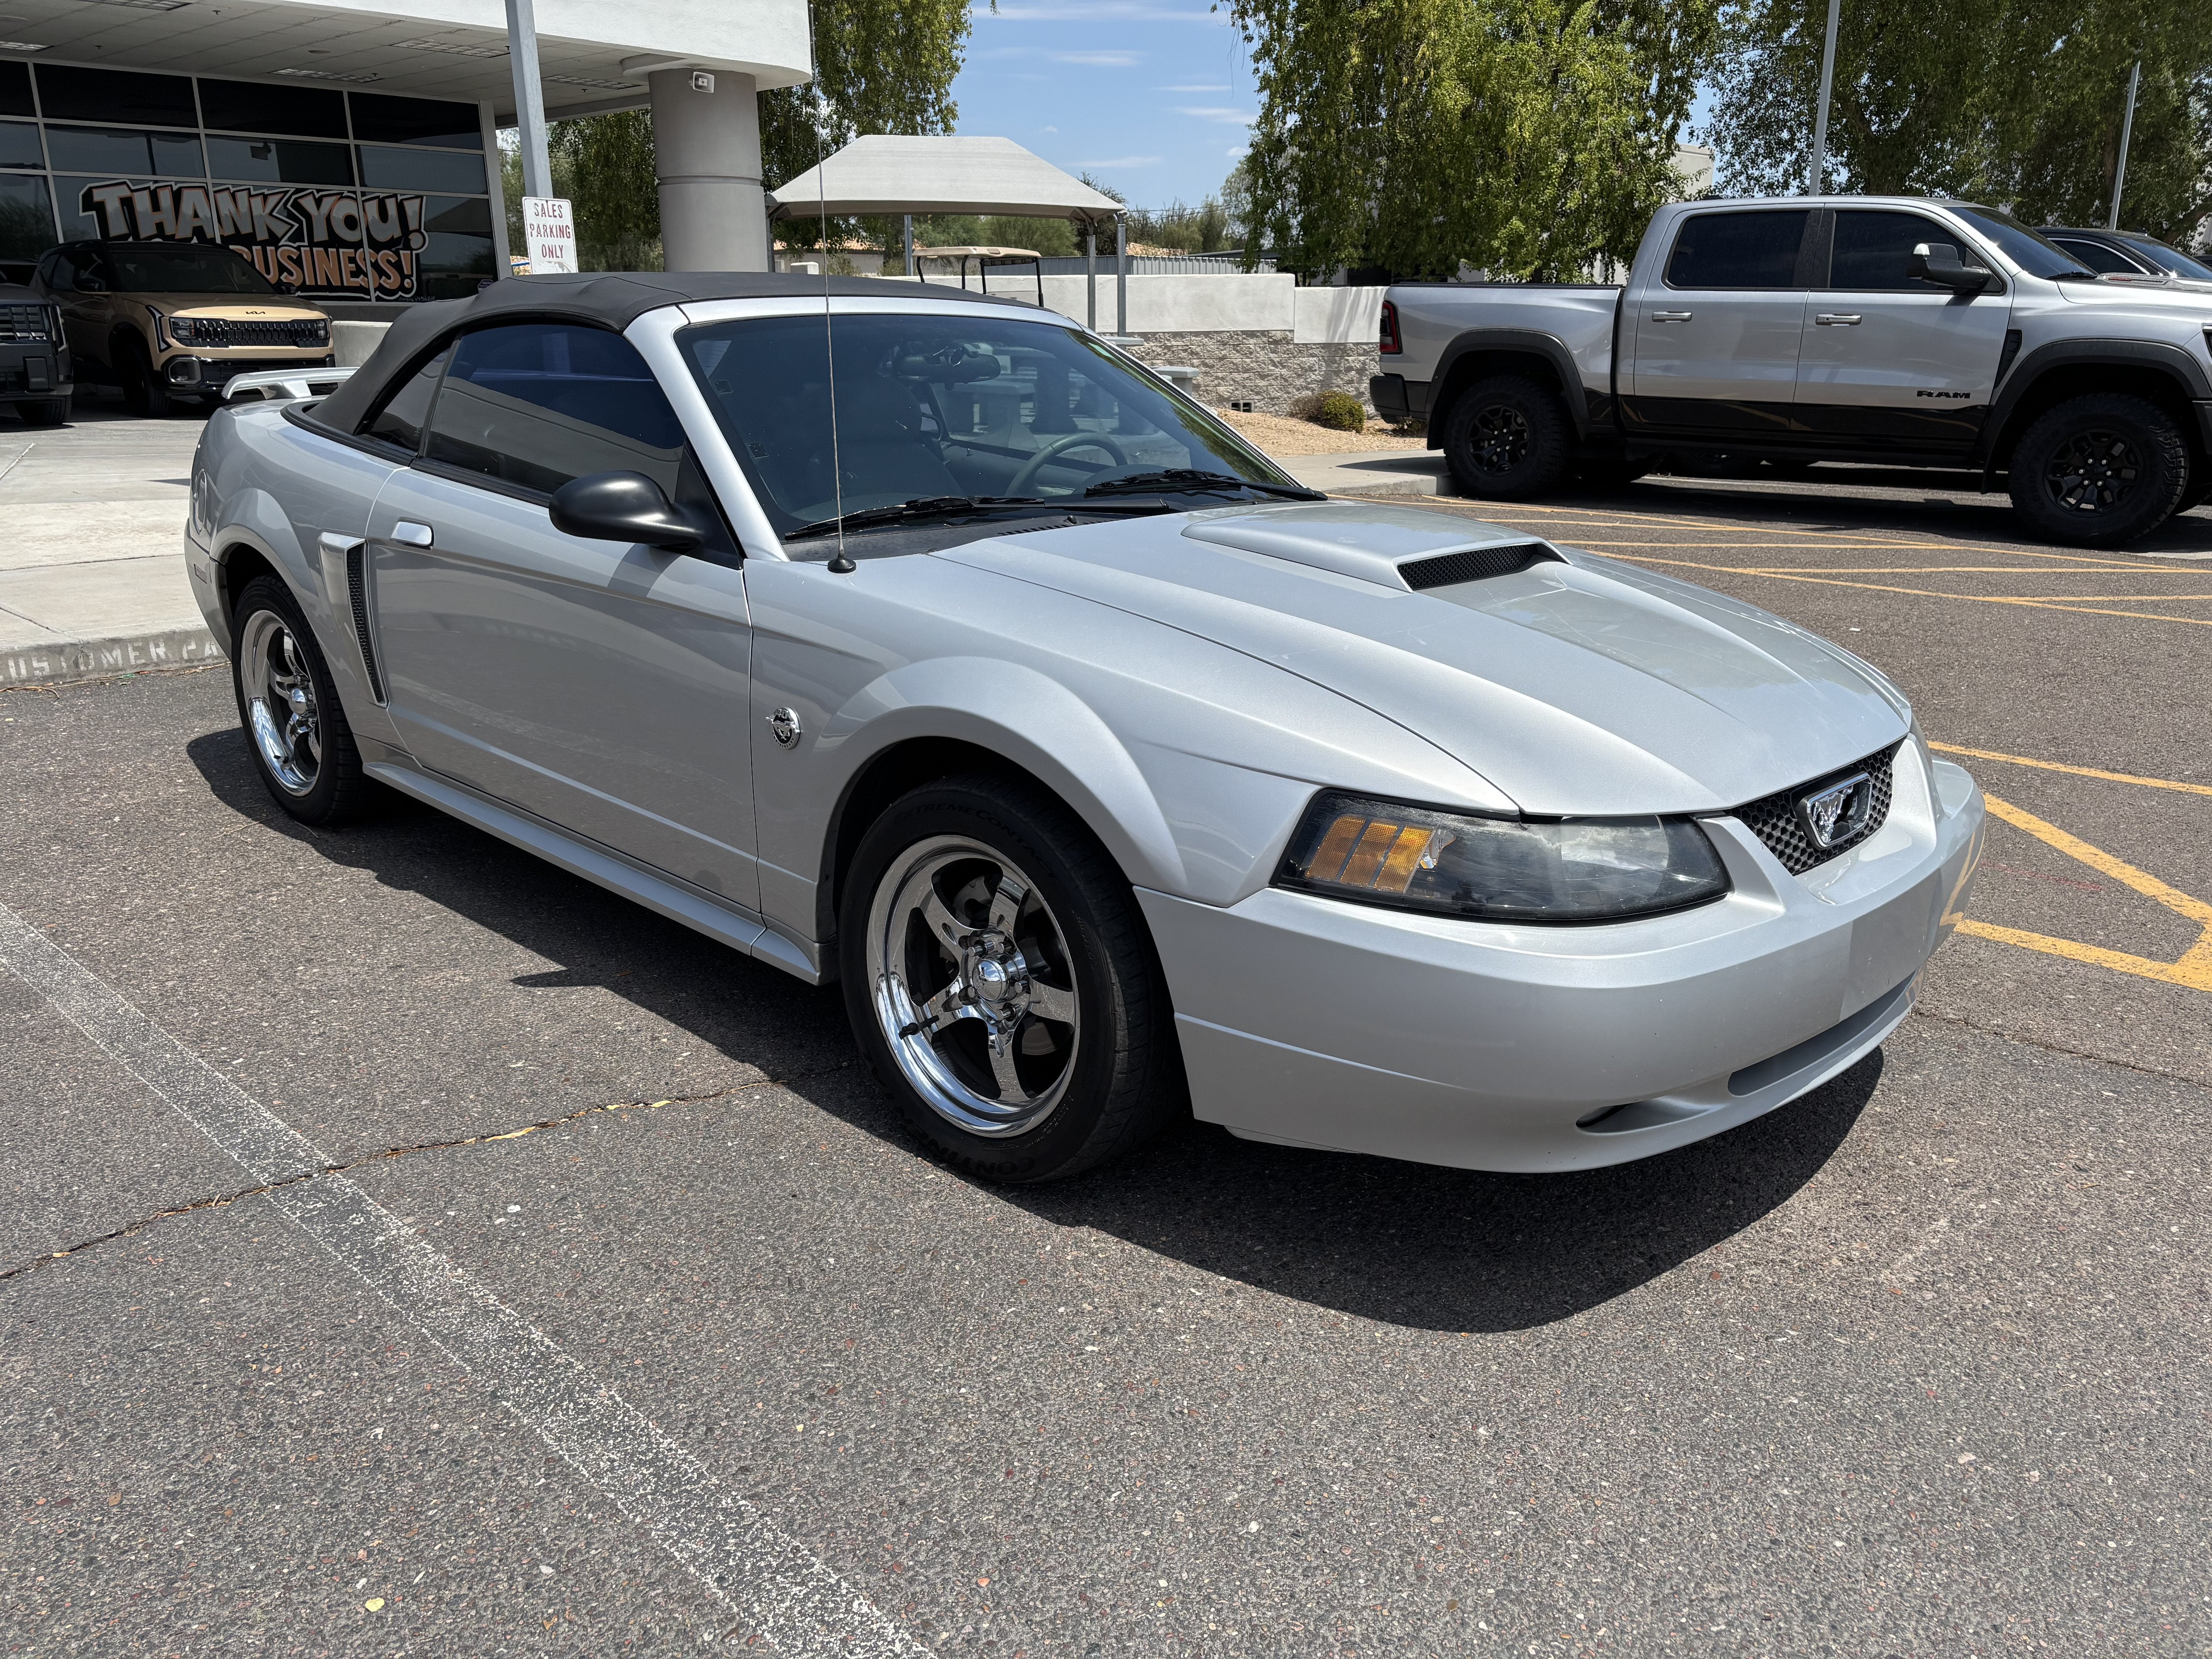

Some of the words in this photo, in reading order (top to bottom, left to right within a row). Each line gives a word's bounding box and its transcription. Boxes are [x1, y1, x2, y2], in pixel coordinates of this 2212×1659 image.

[92, 184, 291, 241] THANK
[298, 194, 424, 249] YOU!
[534, 203, 563, 218] SALES
[529, 223, 571, 239] PARKING
[542, 244, 563, 258] ONLY
[1917, 390, 1971, 399] RAM
